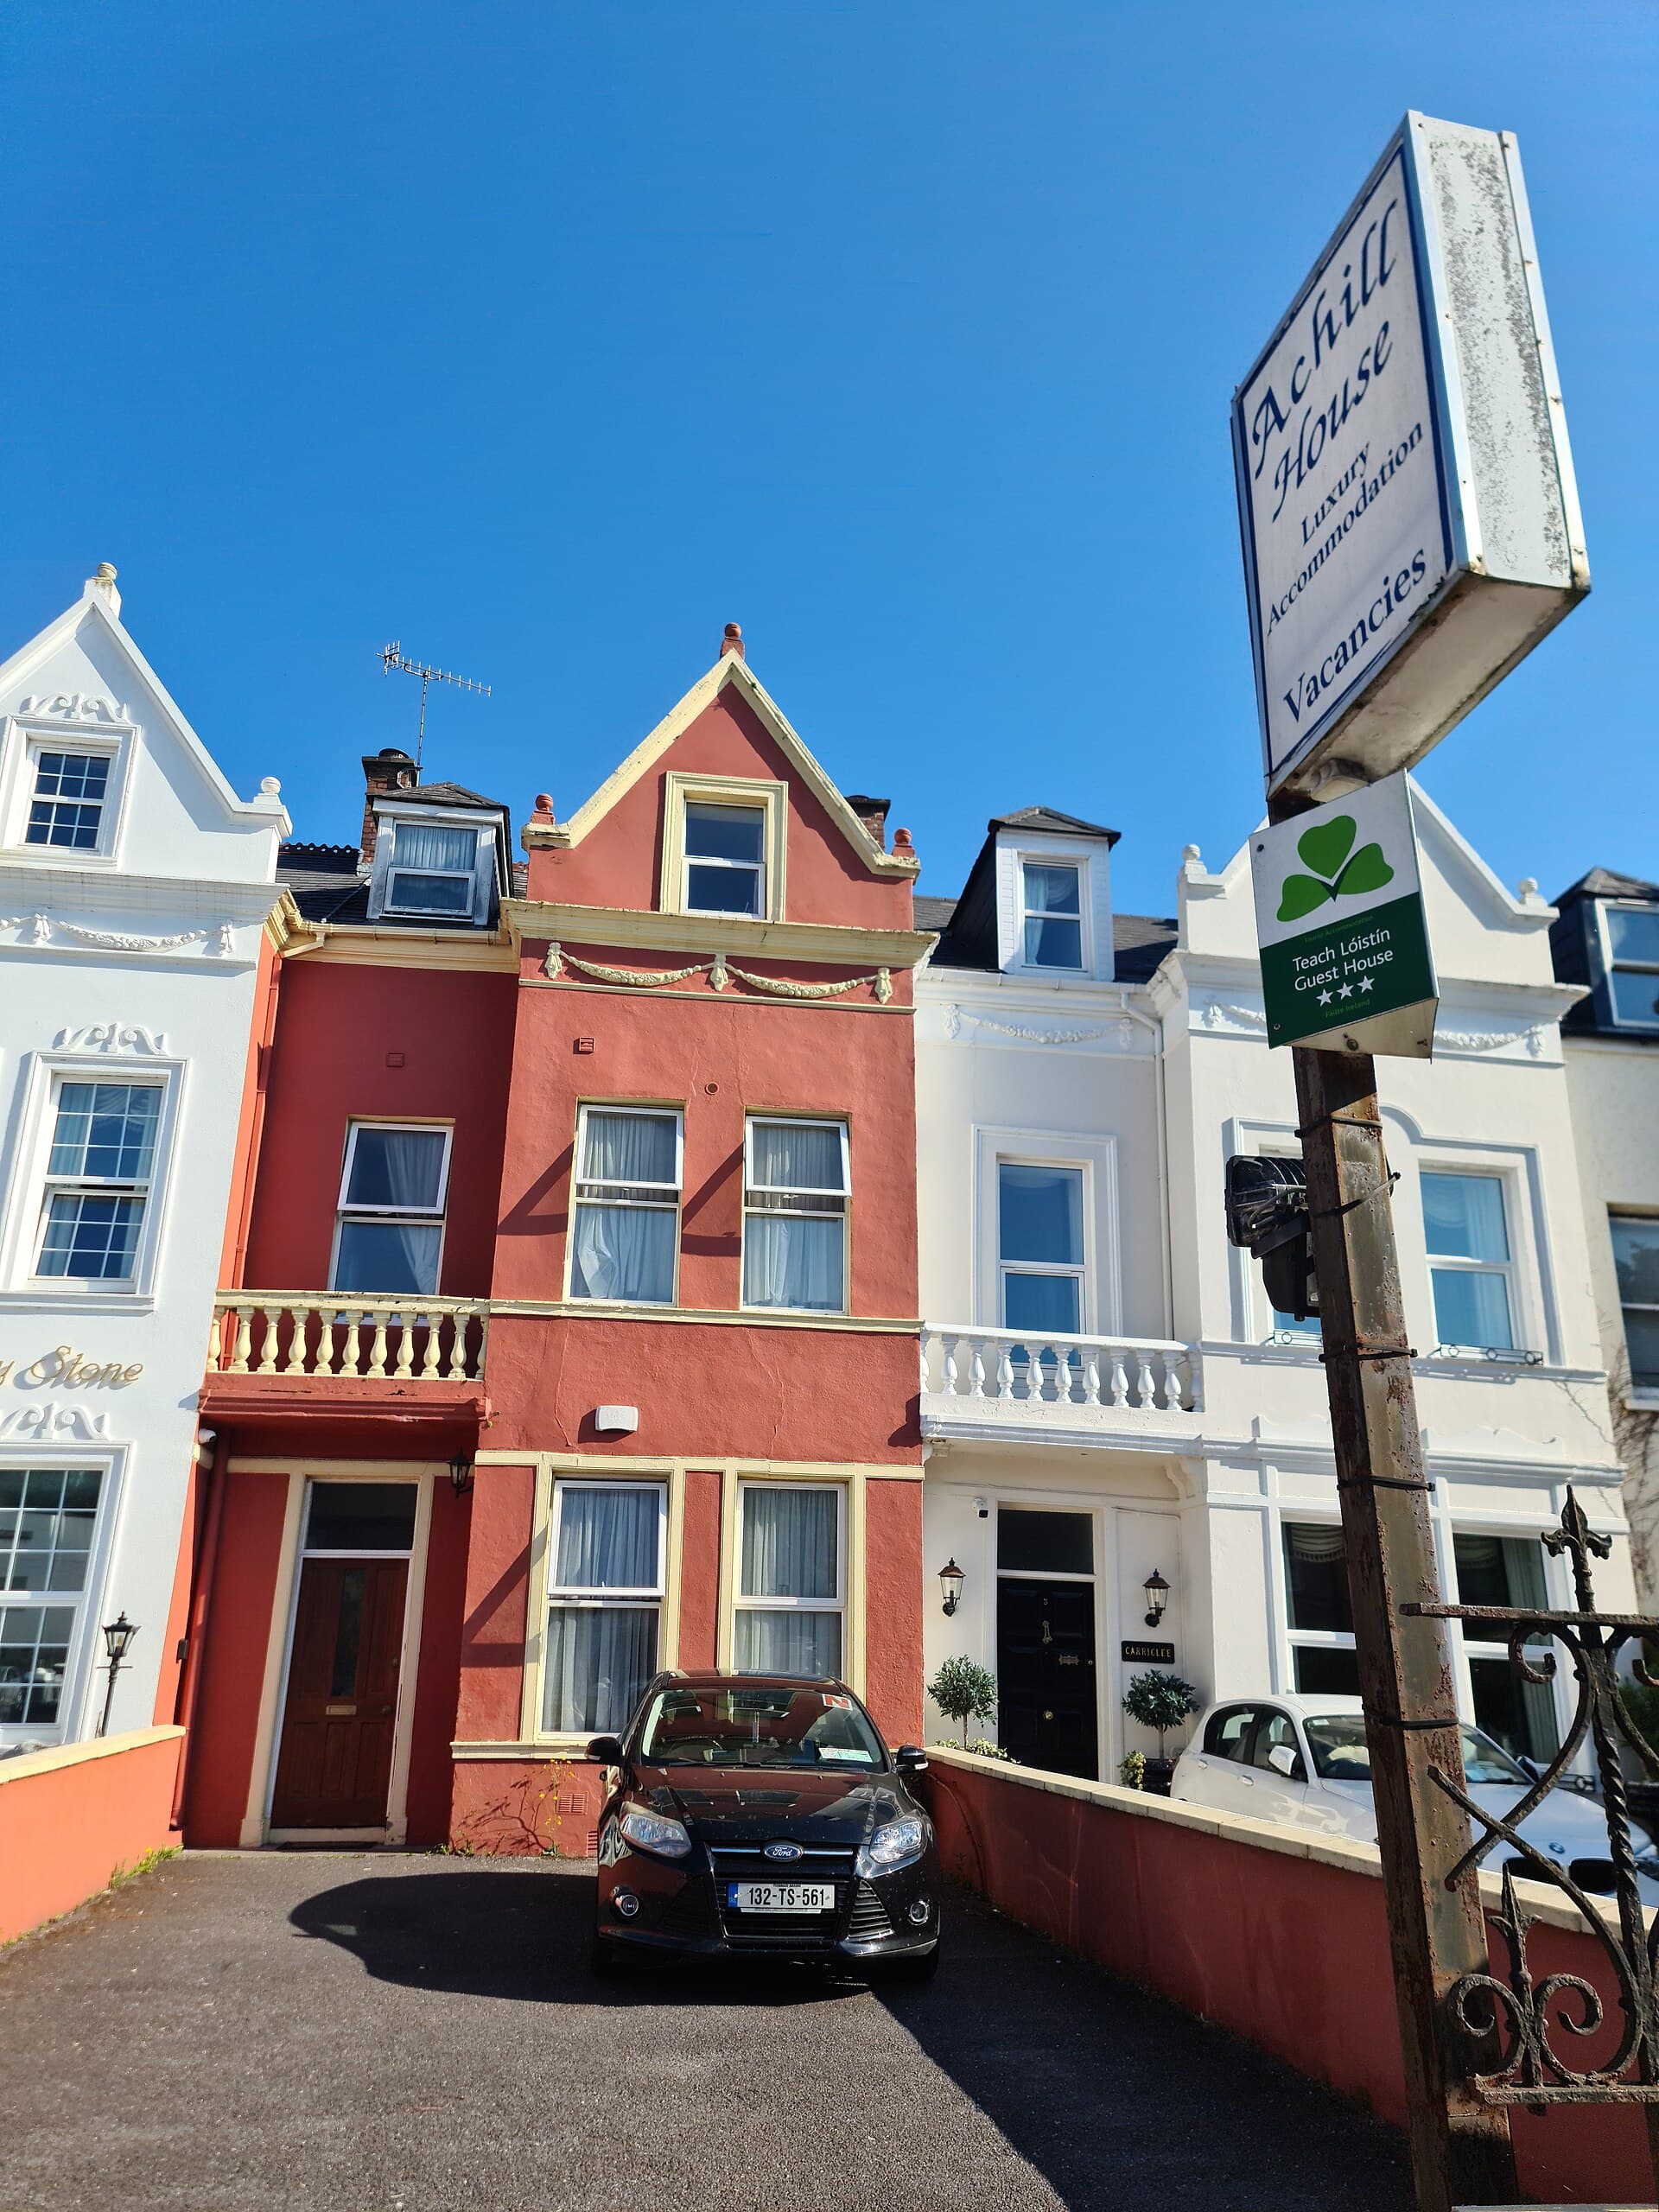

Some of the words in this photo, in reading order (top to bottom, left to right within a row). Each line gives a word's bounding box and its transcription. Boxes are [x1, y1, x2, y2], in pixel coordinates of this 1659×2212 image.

[1252, 198, 1397, 480] Achill
[1272, 321, 1393, 523] House
[1267, 422, 1424, 636] Accommodation
[1301, 442, 1370, 546] Luxury
[1282, 548, 1426, 722] Vacancies
[1293, 946, 1336, 971] Teach
[1340, 928, 1390, 956] Lóistín
[1294, 966, 1339, 991] Guest
[1344, 950, 1394, 976] House
[31, 1345, 143, 1382] Stone
[772, 1845, 793, 1857] Ford
[748, 1887, 824, 1906] 132-TS-561
